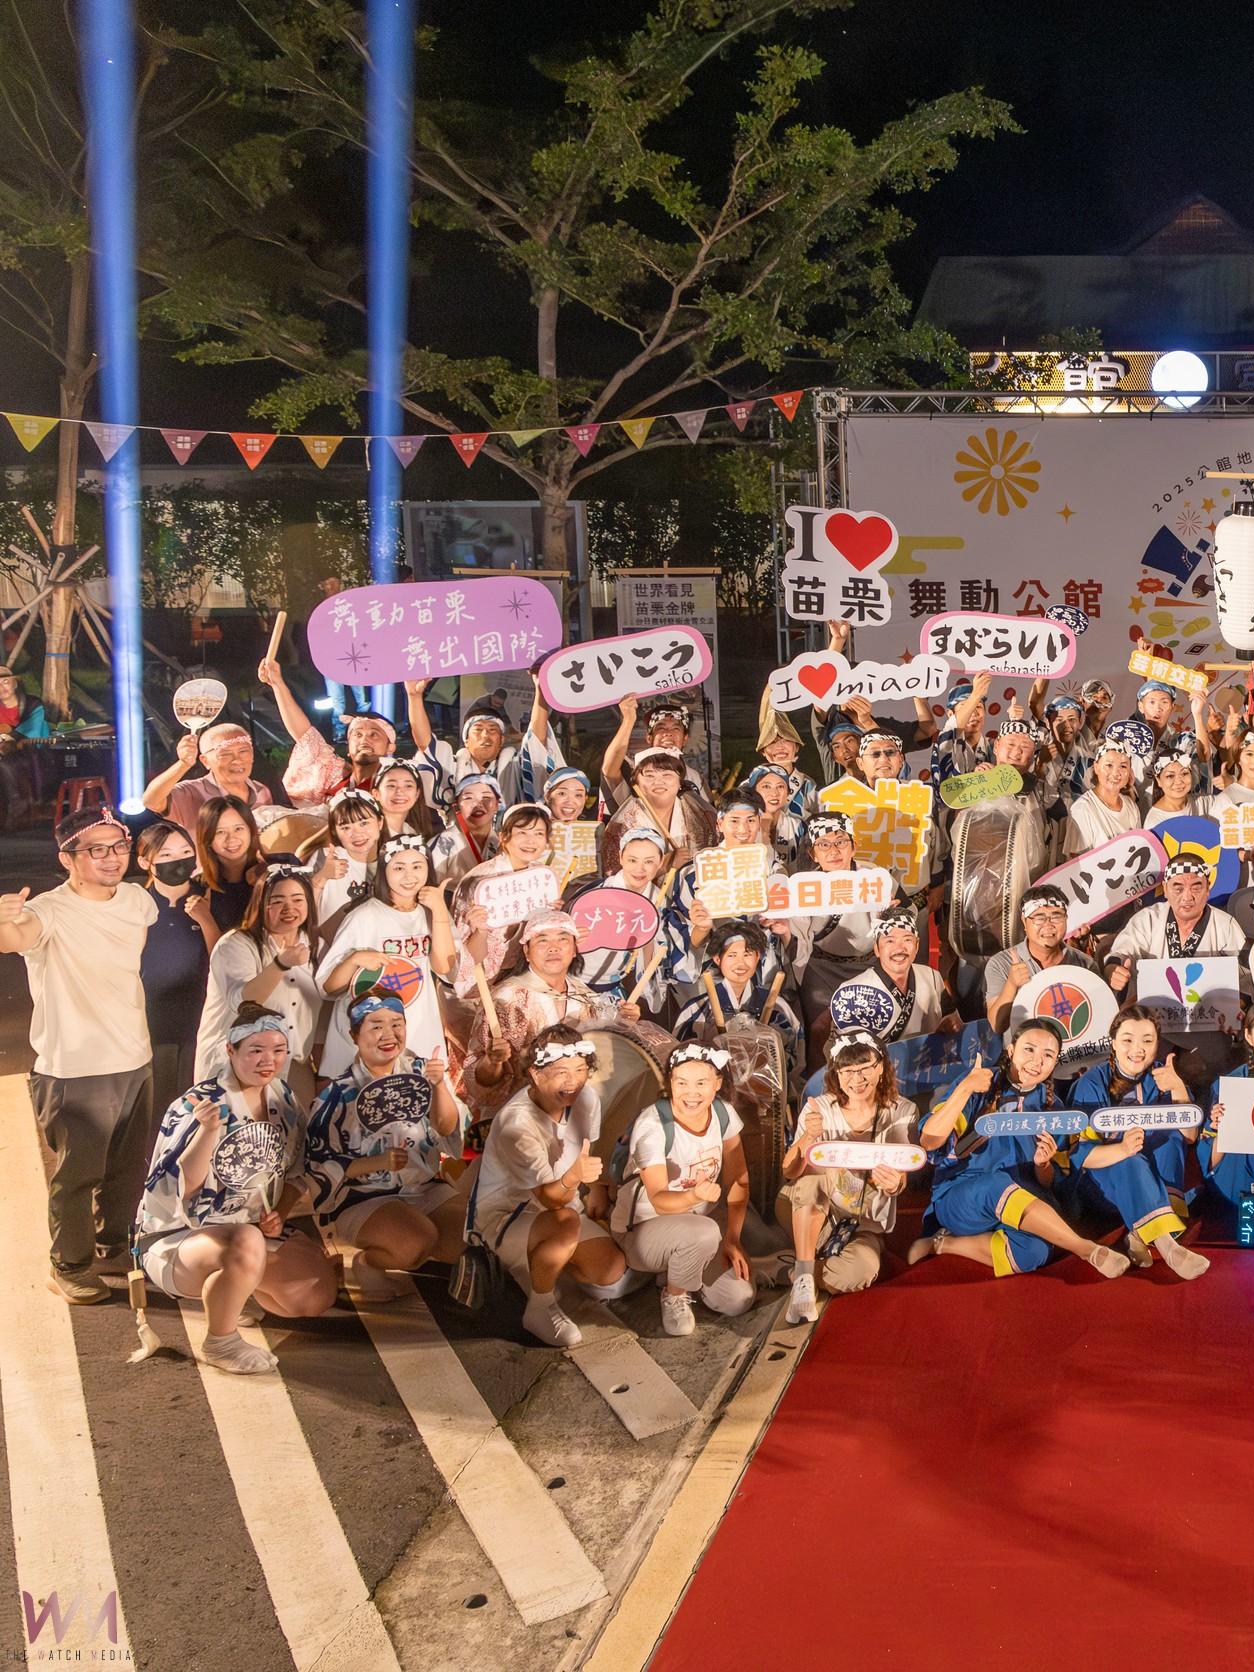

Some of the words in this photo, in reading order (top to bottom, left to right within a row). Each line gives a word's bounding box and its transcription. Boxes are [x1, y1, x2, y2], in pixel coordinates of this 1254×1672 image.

[791, 509, 825, 563] I
[634, 583, 695, 598] 世界看見
[635, 601, 696, 616] 苗栗金牌
[788, 575, 886, 622] 苗栗
[908, 578, 1103, 619] 舞動公館
[327, 589, 476, 638] 舞動苗栗
[401, 626, 549, 676] 舞出國際
[929, 624, 1071, 663] すばらしい
[561, 640, 695, 694] さいこう
[836, 666, 945, 698] miaoli
[989, 661, 1051, 677] subarashii
[701, 848, 767, 882] 苗栗
[1069, 845, 1152, 905] いこう
[701, 880, 766, 913] 金選
[768, 876, 884, 910] 台日農村
[1099, 1110, 1198, 1128] 芸術交流は最高!
